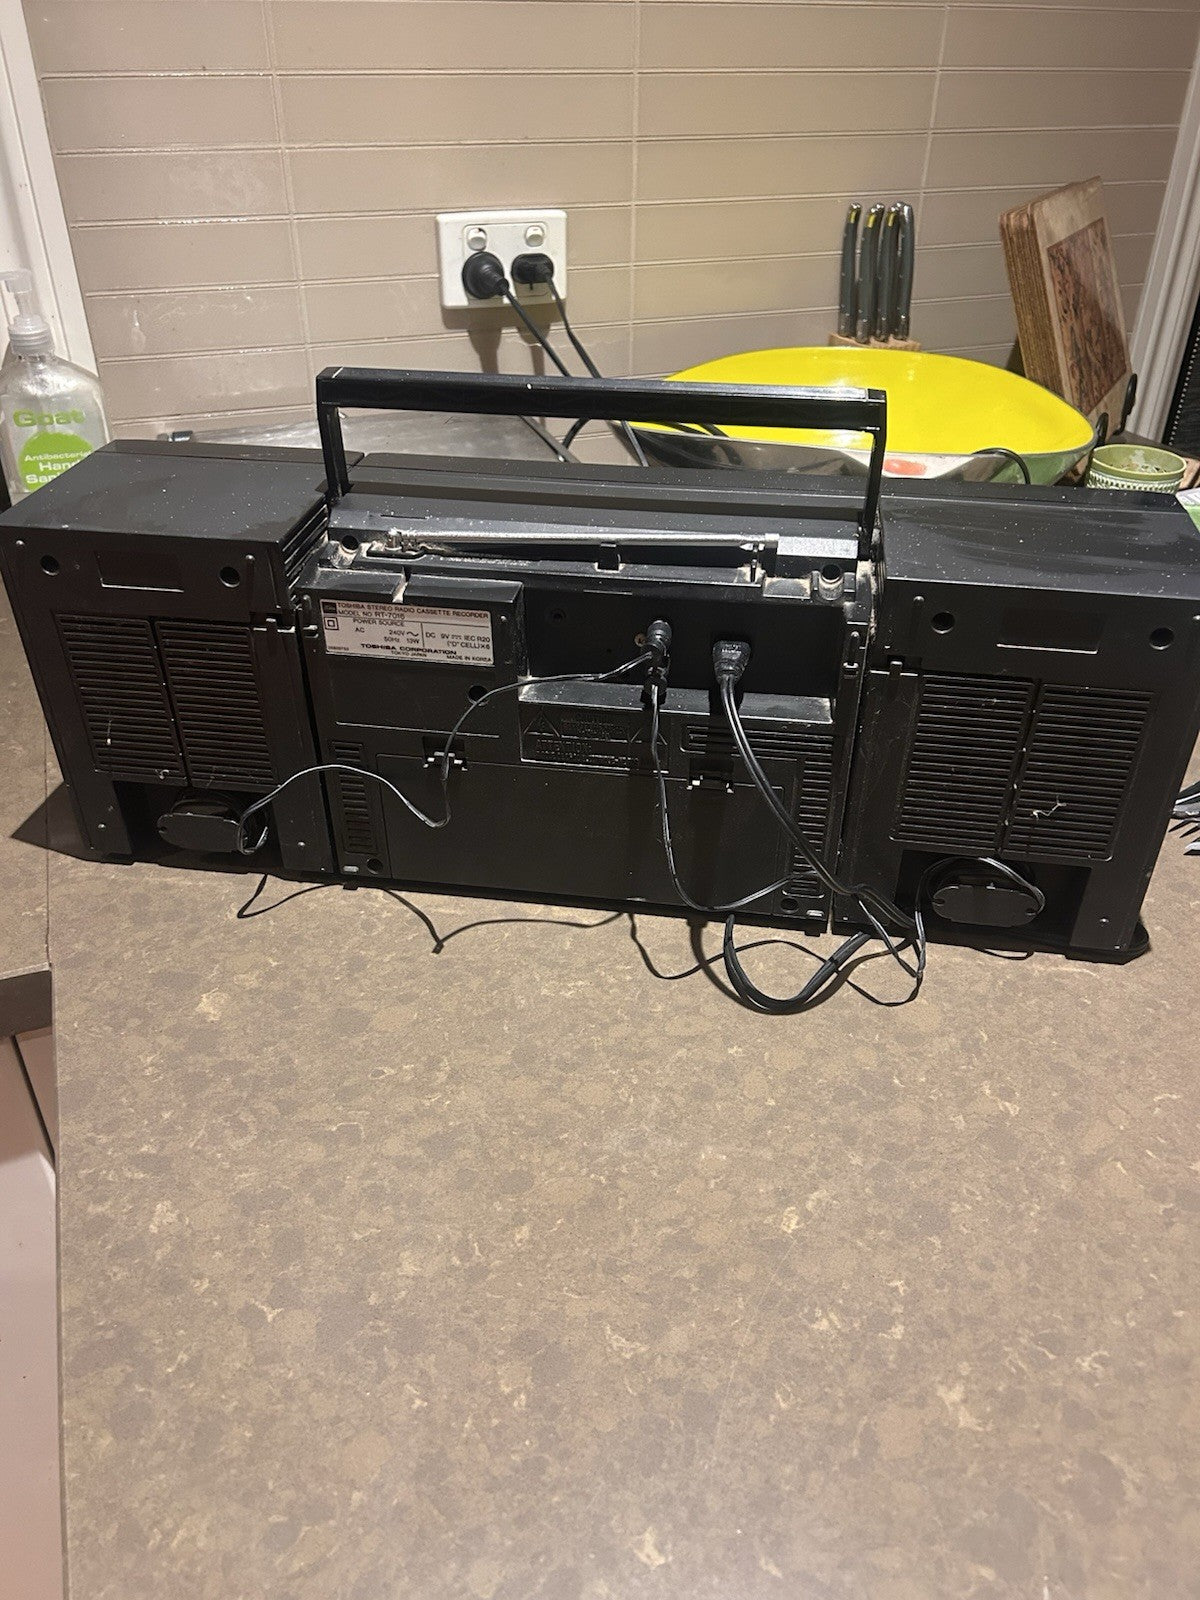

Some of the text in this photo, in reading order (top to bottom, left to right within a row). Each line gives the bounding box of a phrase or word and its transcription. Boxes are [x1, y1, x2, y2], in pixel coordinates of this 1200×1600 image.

[13, 409, 85, 427] Goat
[367, 603, 393, 611] STEREO
[416, 607, 451, 616] CASSETTE
[452, 610, 489, 618] RECORDER
[399, 646, 457, 655] CORPORATION
